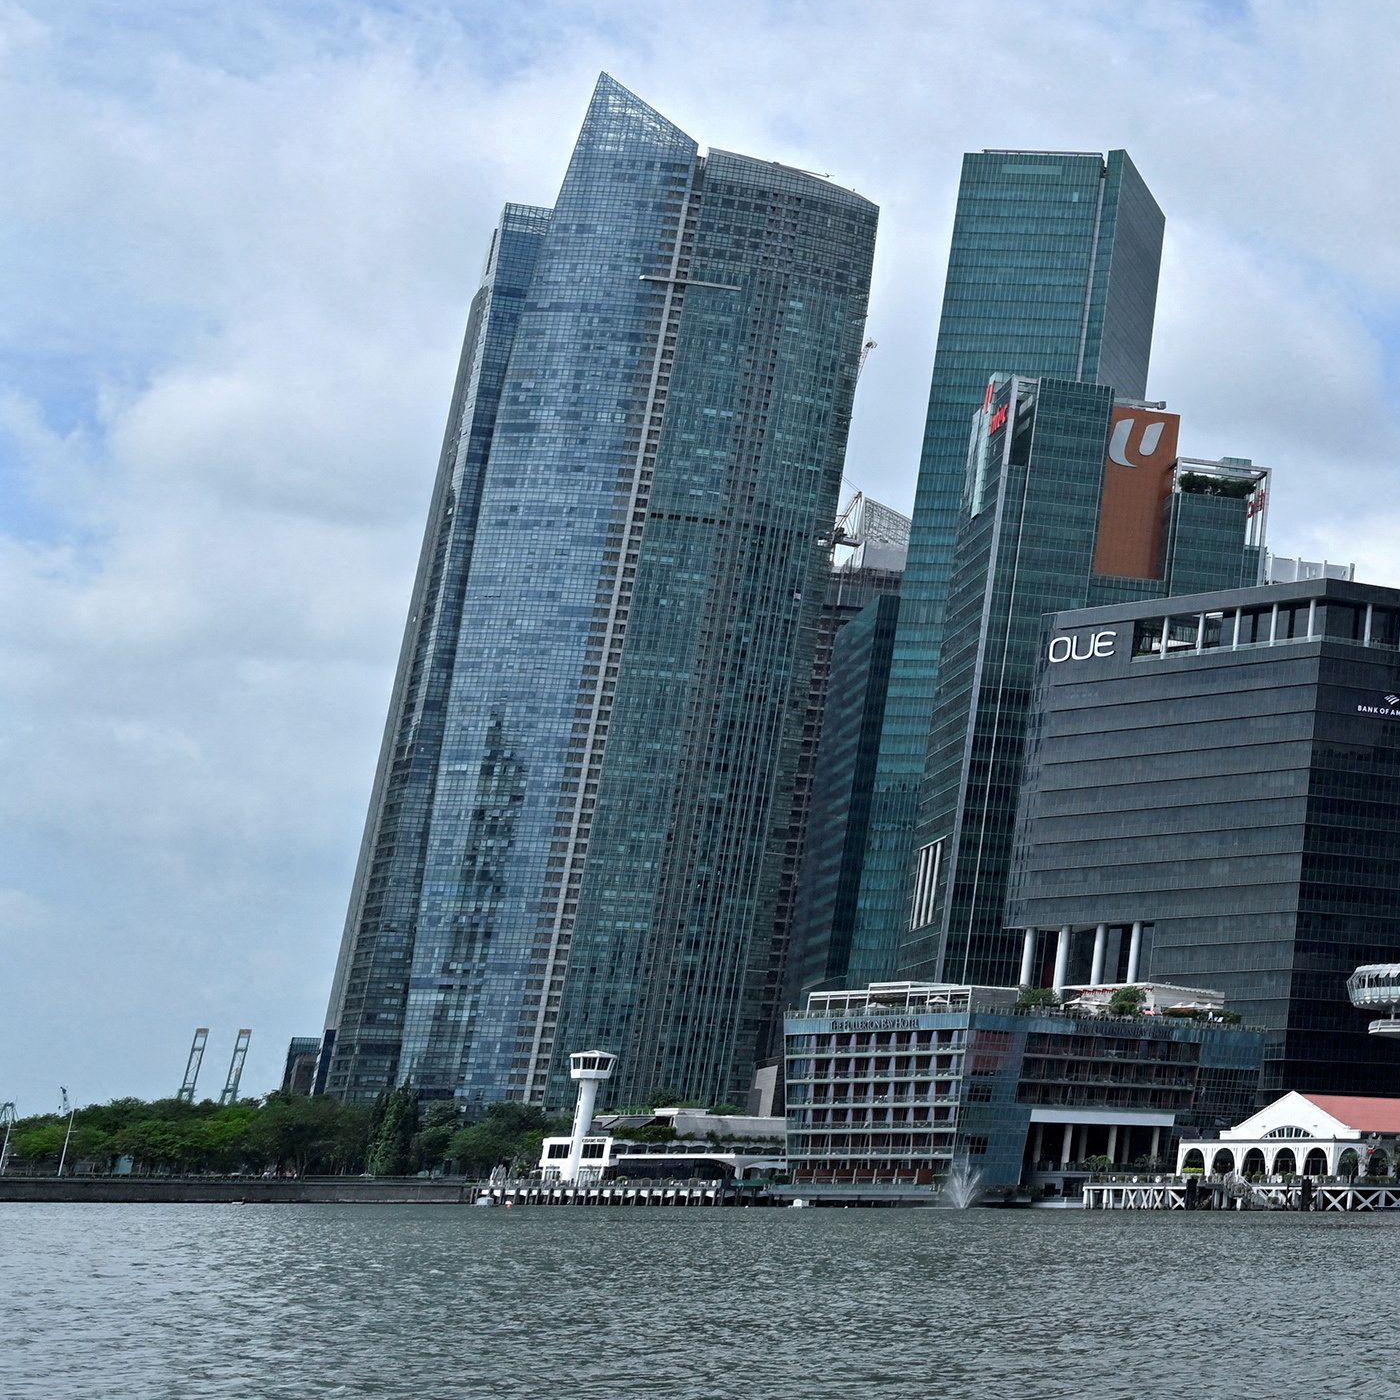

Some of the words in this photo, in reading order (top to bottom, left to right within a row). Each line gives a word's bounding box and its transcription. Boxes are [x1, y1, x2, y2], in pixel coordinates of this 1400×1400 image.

[1048, 631, 1117, 663] OUE
[1357, 705, 1378, 714] BANK
[843, 1019, 880, 1030] FULLERTON
[895, 1018, 919, 1029] HOTEL
